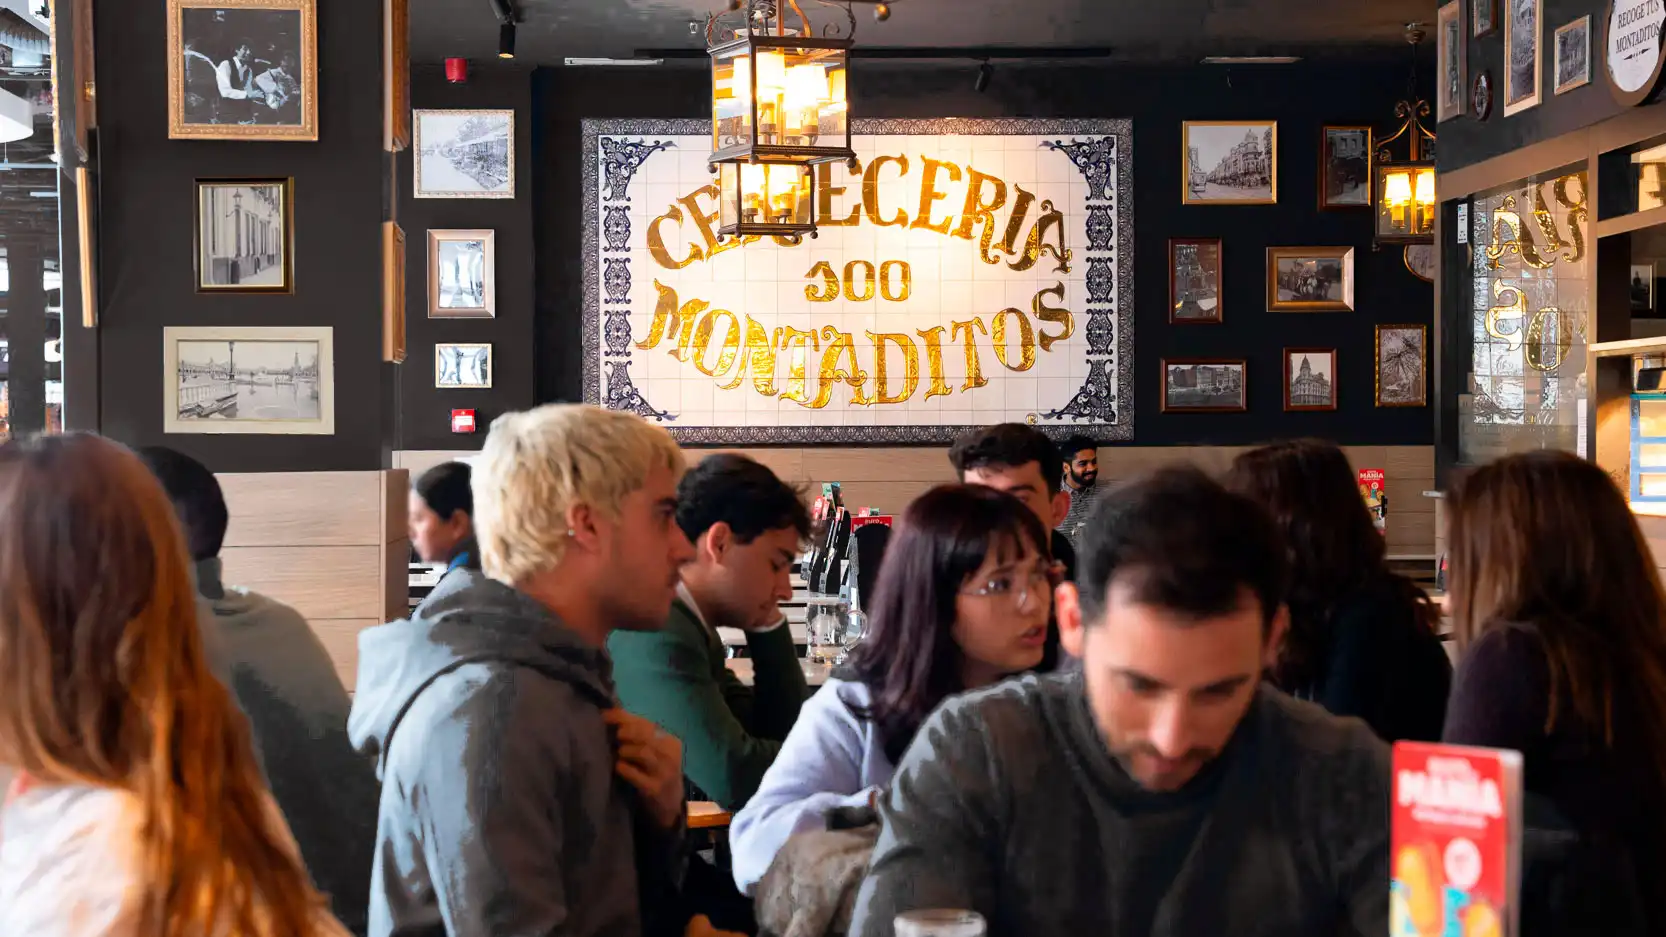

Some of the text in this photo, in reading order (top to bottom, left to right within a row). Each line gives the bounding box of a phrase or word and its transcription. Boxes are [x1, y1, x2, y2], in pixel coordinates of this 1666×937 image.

[1615, 21, 1661, 54] MONTADITOS
[1617, 3, 1645, 29] RECOGE
[646, 154, 1073, 273] CEECERIA
[634, 277, 1076, 409] MONTADITOS
